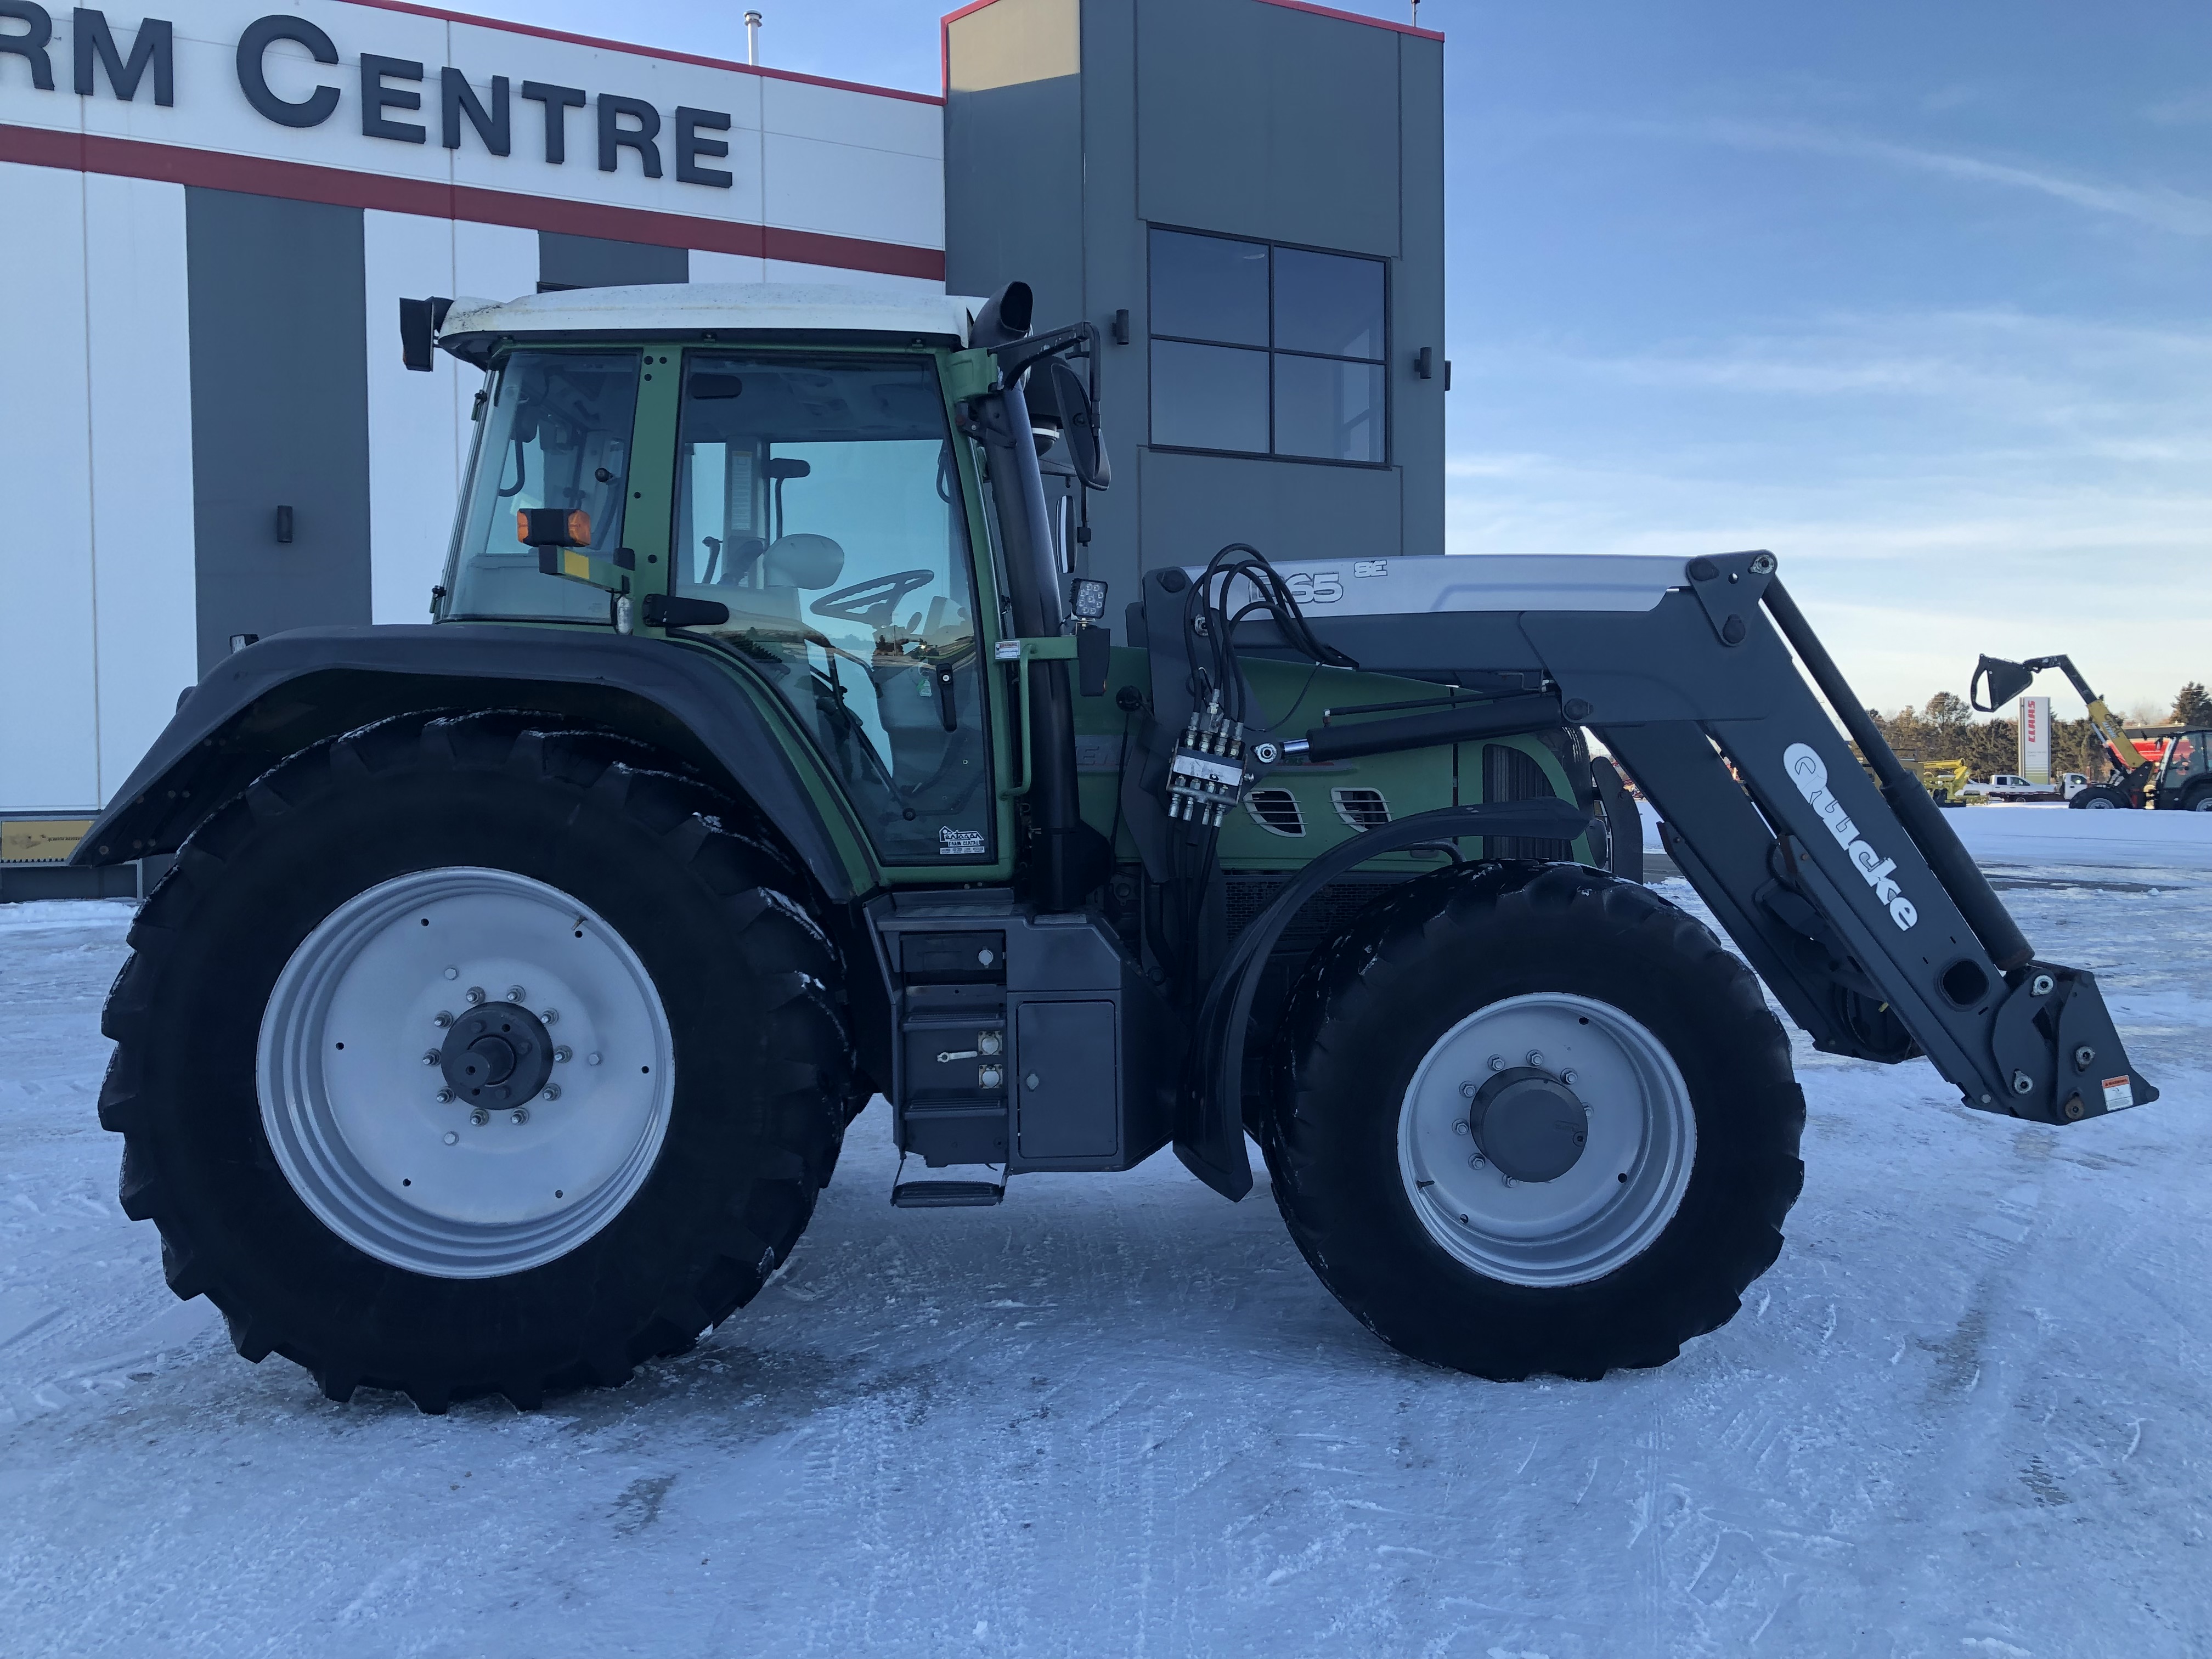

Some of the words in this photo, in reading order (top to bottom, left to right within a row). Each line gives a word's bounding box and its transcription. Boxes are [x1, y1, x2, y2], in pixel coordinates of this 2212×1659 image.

[236, 14, 733, 189] CENTRE
[2028, 700, 2036, 743] CLAAS
[1783, 742, 1918, 932] Quicke
